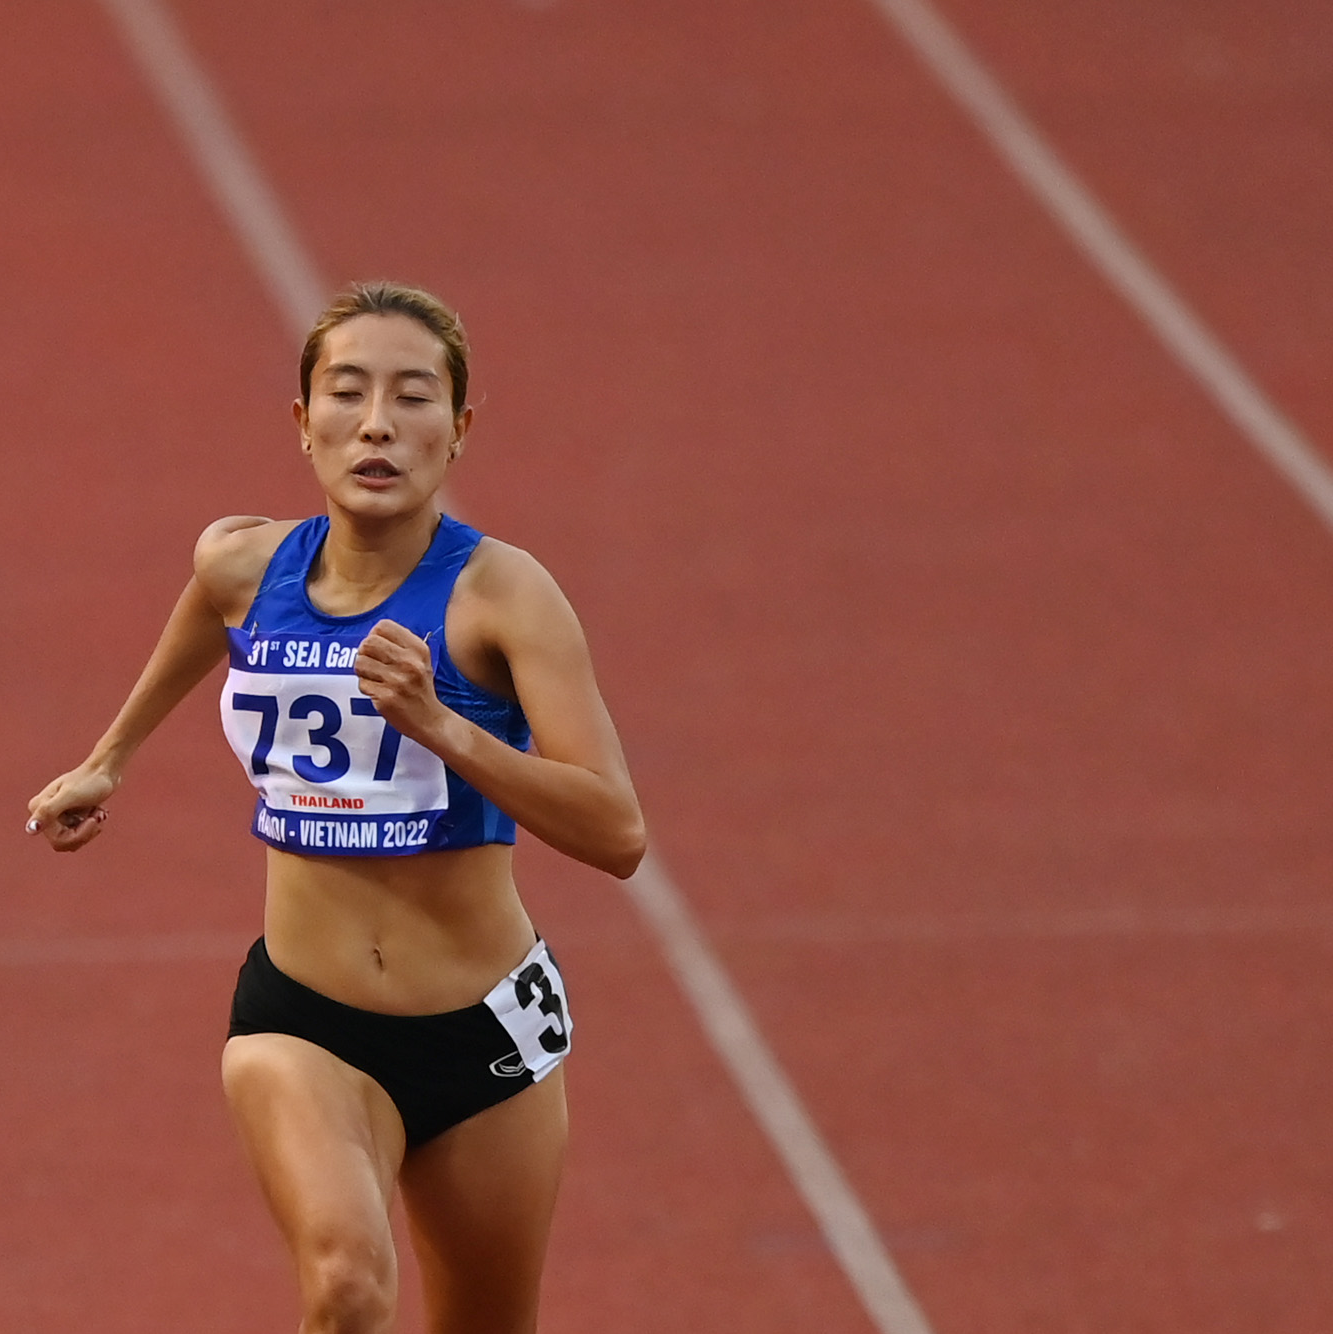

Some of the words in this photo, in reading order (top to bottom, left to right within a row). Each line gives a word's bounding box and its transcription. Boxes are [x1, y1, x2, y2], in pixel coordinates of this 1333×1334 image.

[283, 640, 320, 668] SEA
[232, 692, 402, 783] 737
[290, 794, 364, 809] THAILAND
[257, 808, 286, 843] HANOI
[300, 820, 377, 848] VIETNAM
[383, 819, 429, 848] 2022
[514, 962, 568, 1054] 3
